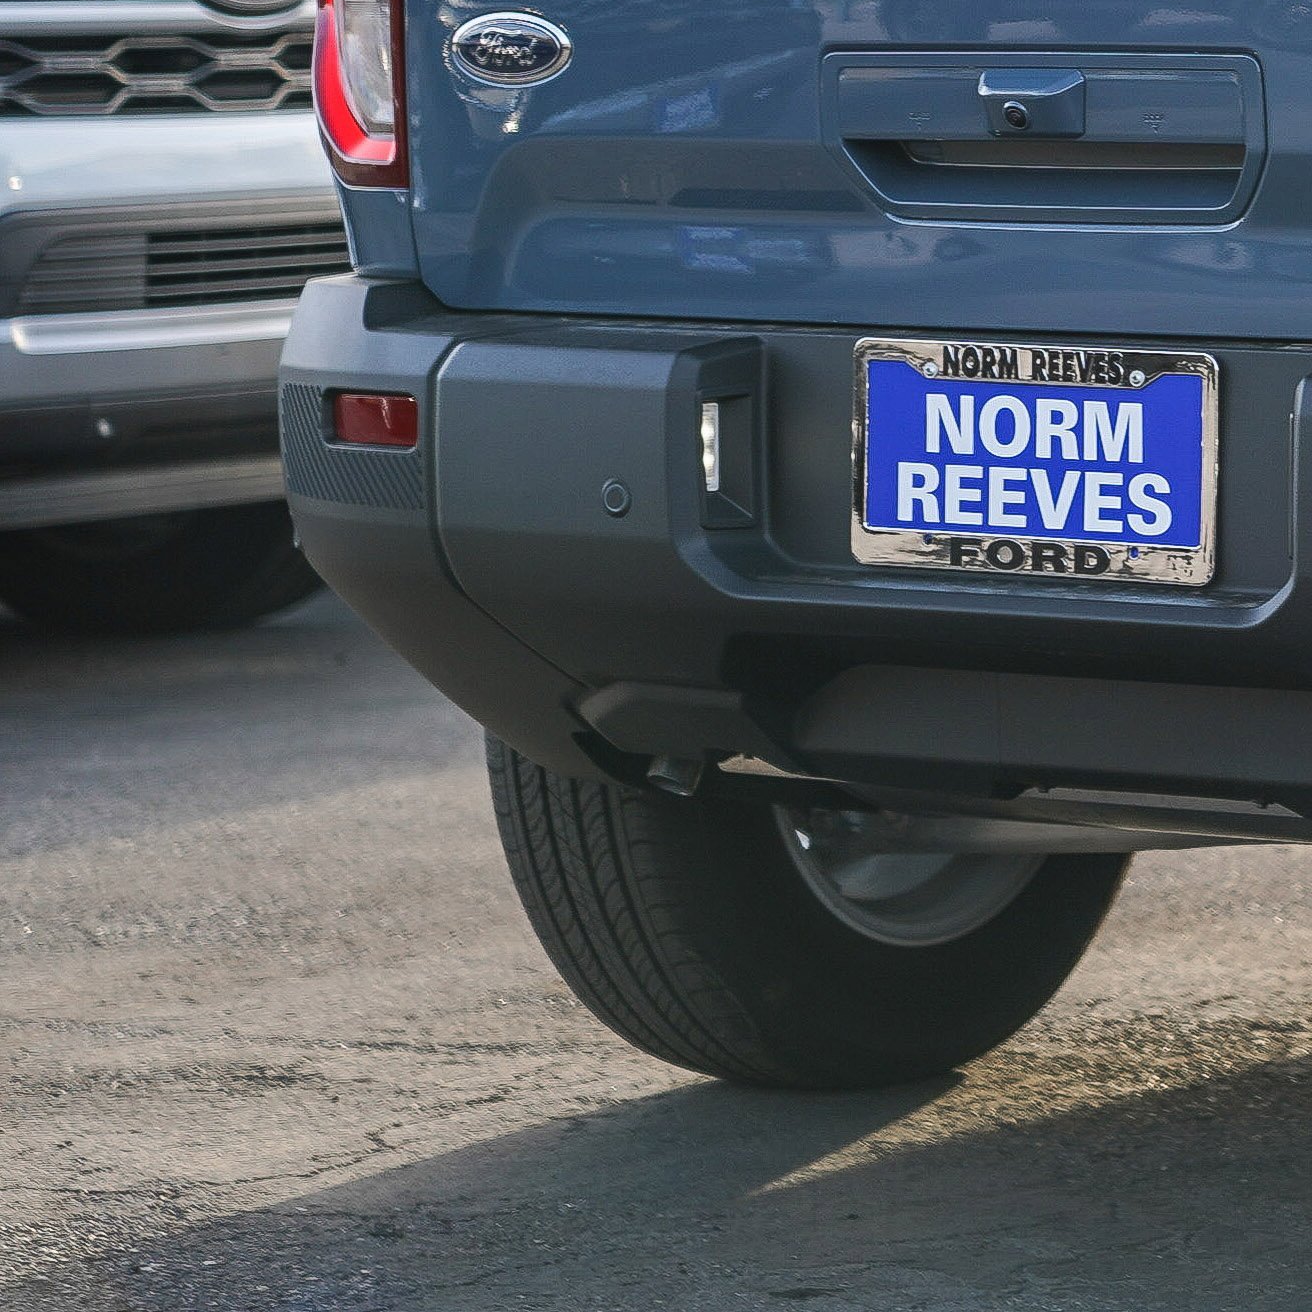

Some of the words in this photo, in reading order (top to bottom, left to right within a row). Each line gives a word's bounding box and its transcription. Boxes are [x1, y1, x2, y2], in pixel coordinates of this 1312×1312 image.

[942, 344, 1019, 381] NORM
[1031, 348, 1125, 386] REEVES
[925, 393, 1144, 464] NORM
[897, 461, 1173, 537] REEVES
[948, 537, 1113, 576] FORD
